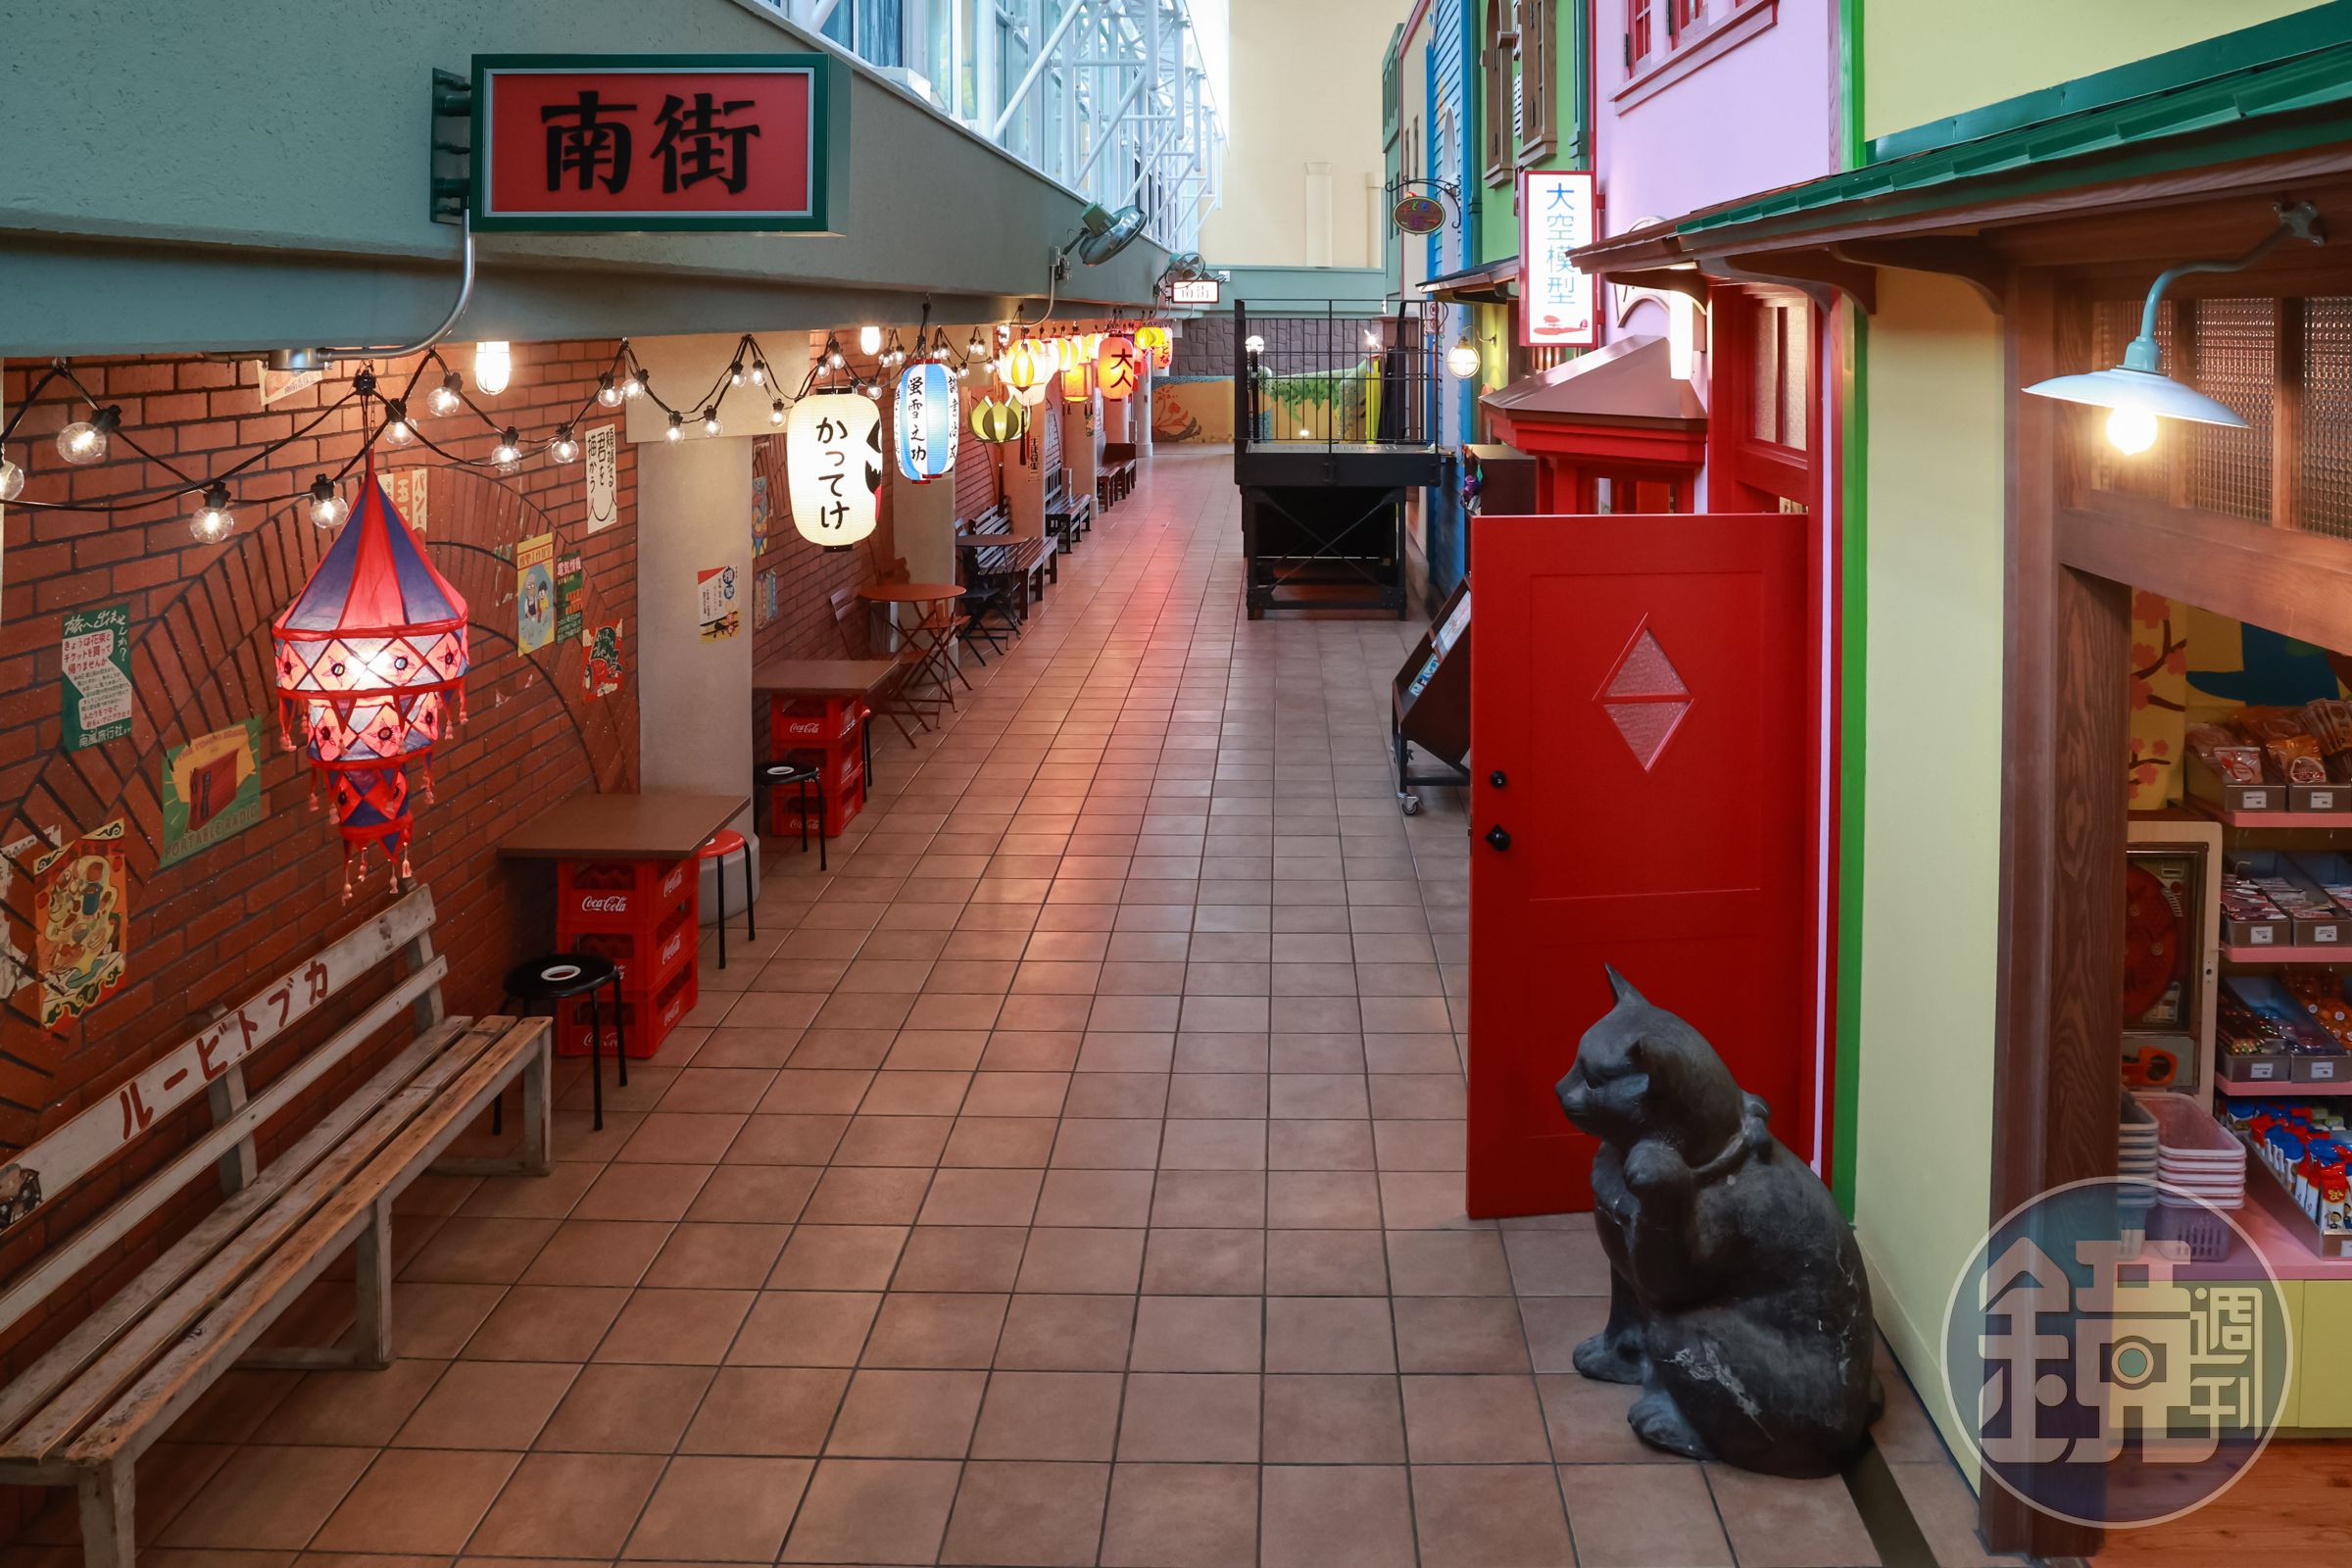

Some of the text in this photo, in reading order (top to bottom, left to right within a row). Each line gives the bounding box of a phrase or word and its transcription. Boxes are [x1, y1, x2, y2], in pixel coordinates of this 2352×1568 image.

[541, 90, 760, 195] 南街
[1546, 182, 1576, 305] 大空模型
[1110, 348, 1134, 389] 大人
[907, 376, 927, 462] 螢雪之功
[815, 416, 851, 530] かってけ
[789, 722, 819, 734] Coca-Cola
[224, 804, 258, 835] RADIO
[581, 895, 628, 912] Coca-Cola
